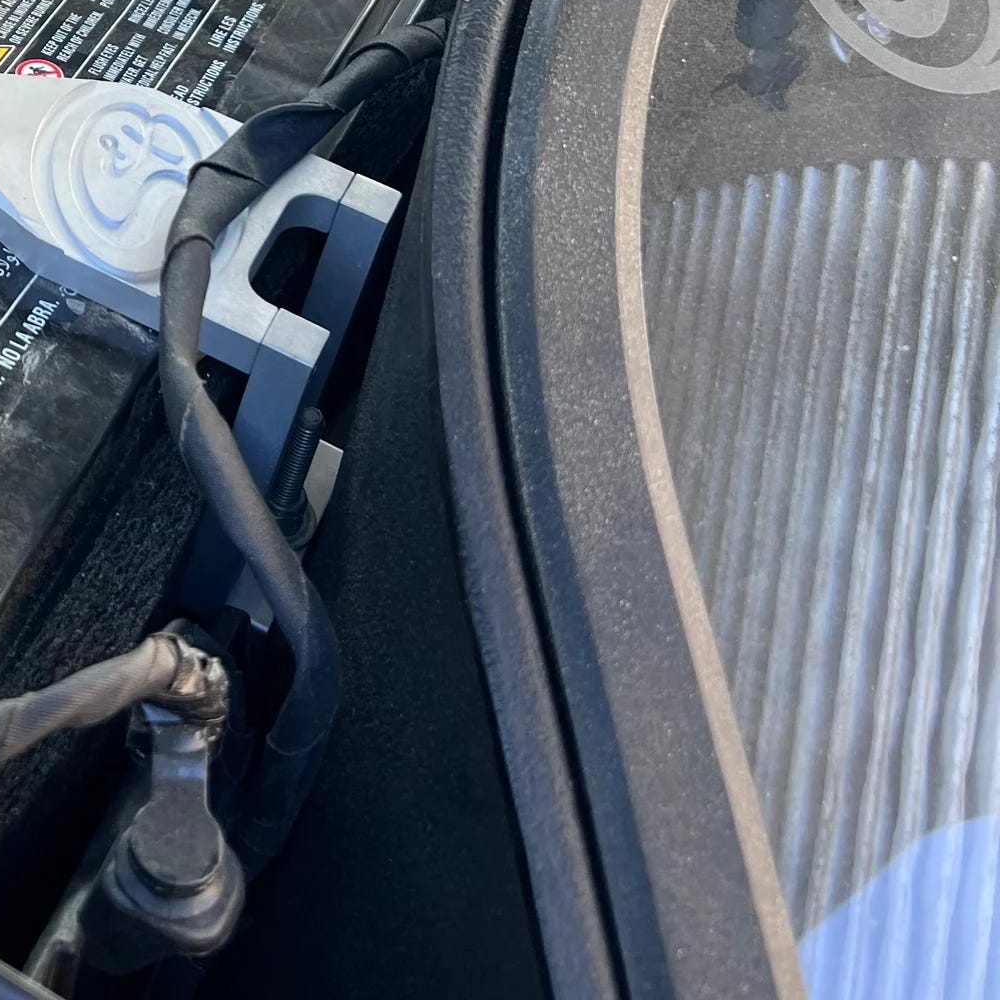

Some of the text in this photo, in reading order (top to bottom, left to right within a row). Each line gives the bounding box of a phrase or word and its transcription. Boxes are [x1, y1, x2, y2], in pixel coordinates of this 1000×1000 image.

[8, 33, 24, 45] OR
[15, 14, 39, 37] SEVERE
[40, 12, 82, 56] KEEP OUT OF THE
[207, 15, 237, 48] LIRE LES
[55, 41, 78, 63] REACH
[69, 34, 83, 45] OF
[87, 43, 119, 76] FLUSH EYES
[103, 32, 146, 81] IMMEDIATELY WITH
[120, 54, 148, 83] ATER. GET
[135, 68, 159, 90] EDICAL
[149, 54, 166, 71] HELP
[186, 59, 227, 106] STRUCTIONS.
[168, 84, 189, 102] EAD
[9, 331, 34, 351] LA
[22, 299, 59, 335] ABRA.
